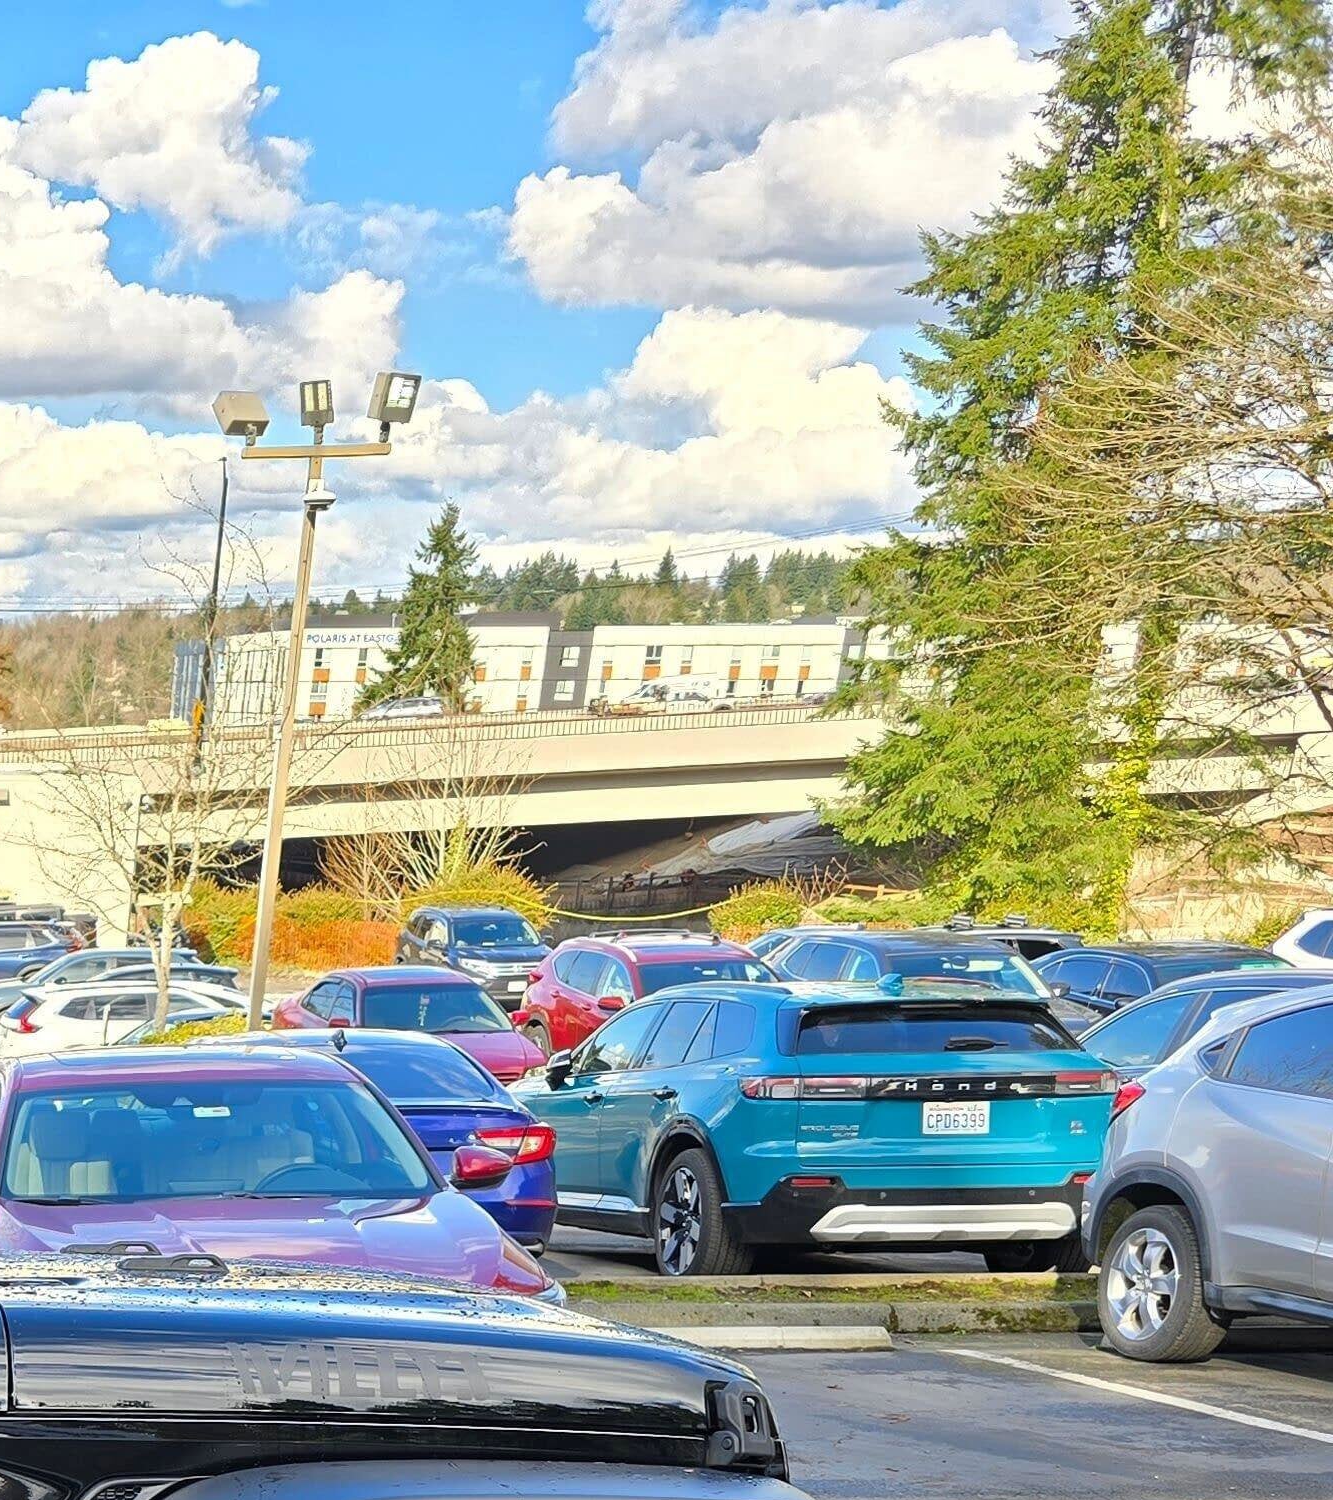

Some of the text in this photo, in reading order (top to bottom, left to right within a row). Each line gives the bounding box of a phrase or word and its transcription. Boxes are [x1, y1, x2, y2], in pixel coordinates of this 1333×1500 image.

[306, 634, 347, 644] POLARIS
[349, 634, 361, 644] AT
[927, 1113, 986, 1129] CPD6399
